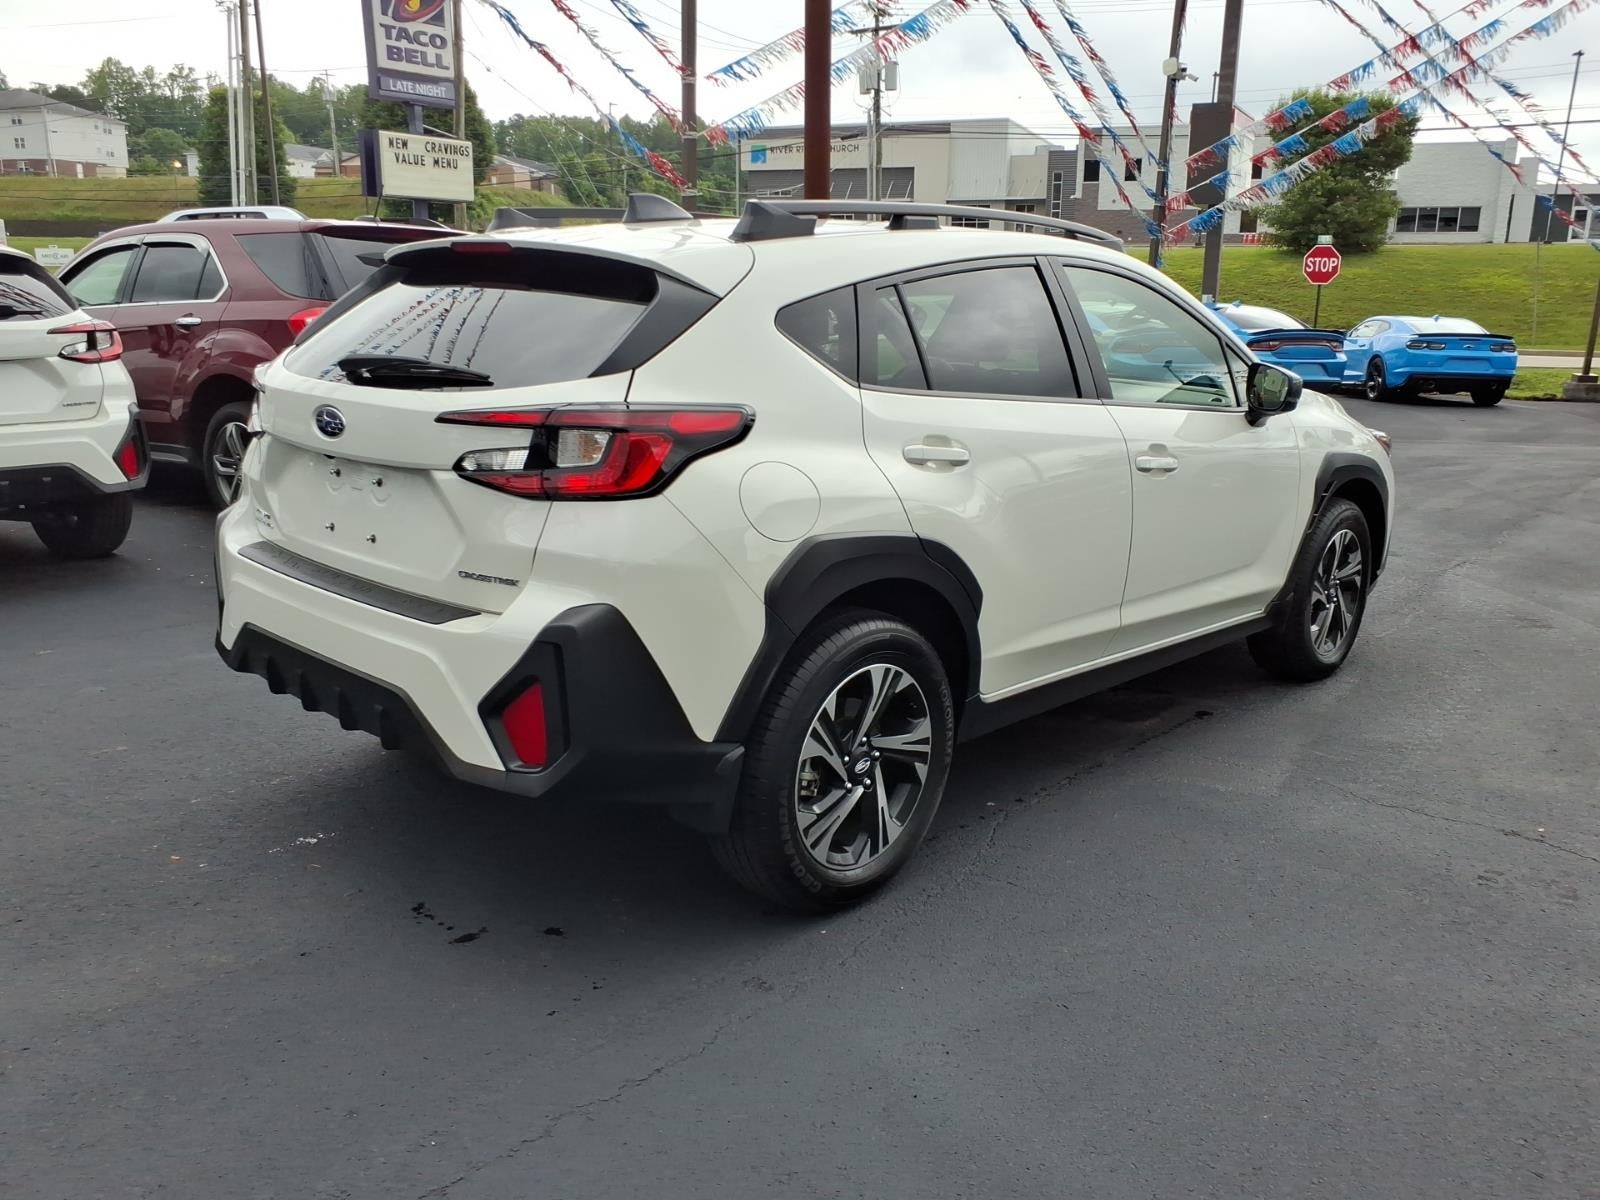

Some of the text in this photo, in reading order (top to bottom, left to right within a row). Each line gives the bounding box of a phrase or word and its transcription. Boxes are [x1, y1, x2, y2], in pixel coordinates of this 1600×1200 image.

[379, 23, 448, 50] TACO
[386, 44, 450, 70] BELL
[390, 79, 446, 98] LATE NIGHT
[388, 137, 470, 157] NEW CRAVINGS
[769, 146, 793, 154] RIVER
[831, 144, 860, 153] HURCH
[394, 152, 458, 170] VALUE MENU
[1305, 257, 1338, 273] STOP
